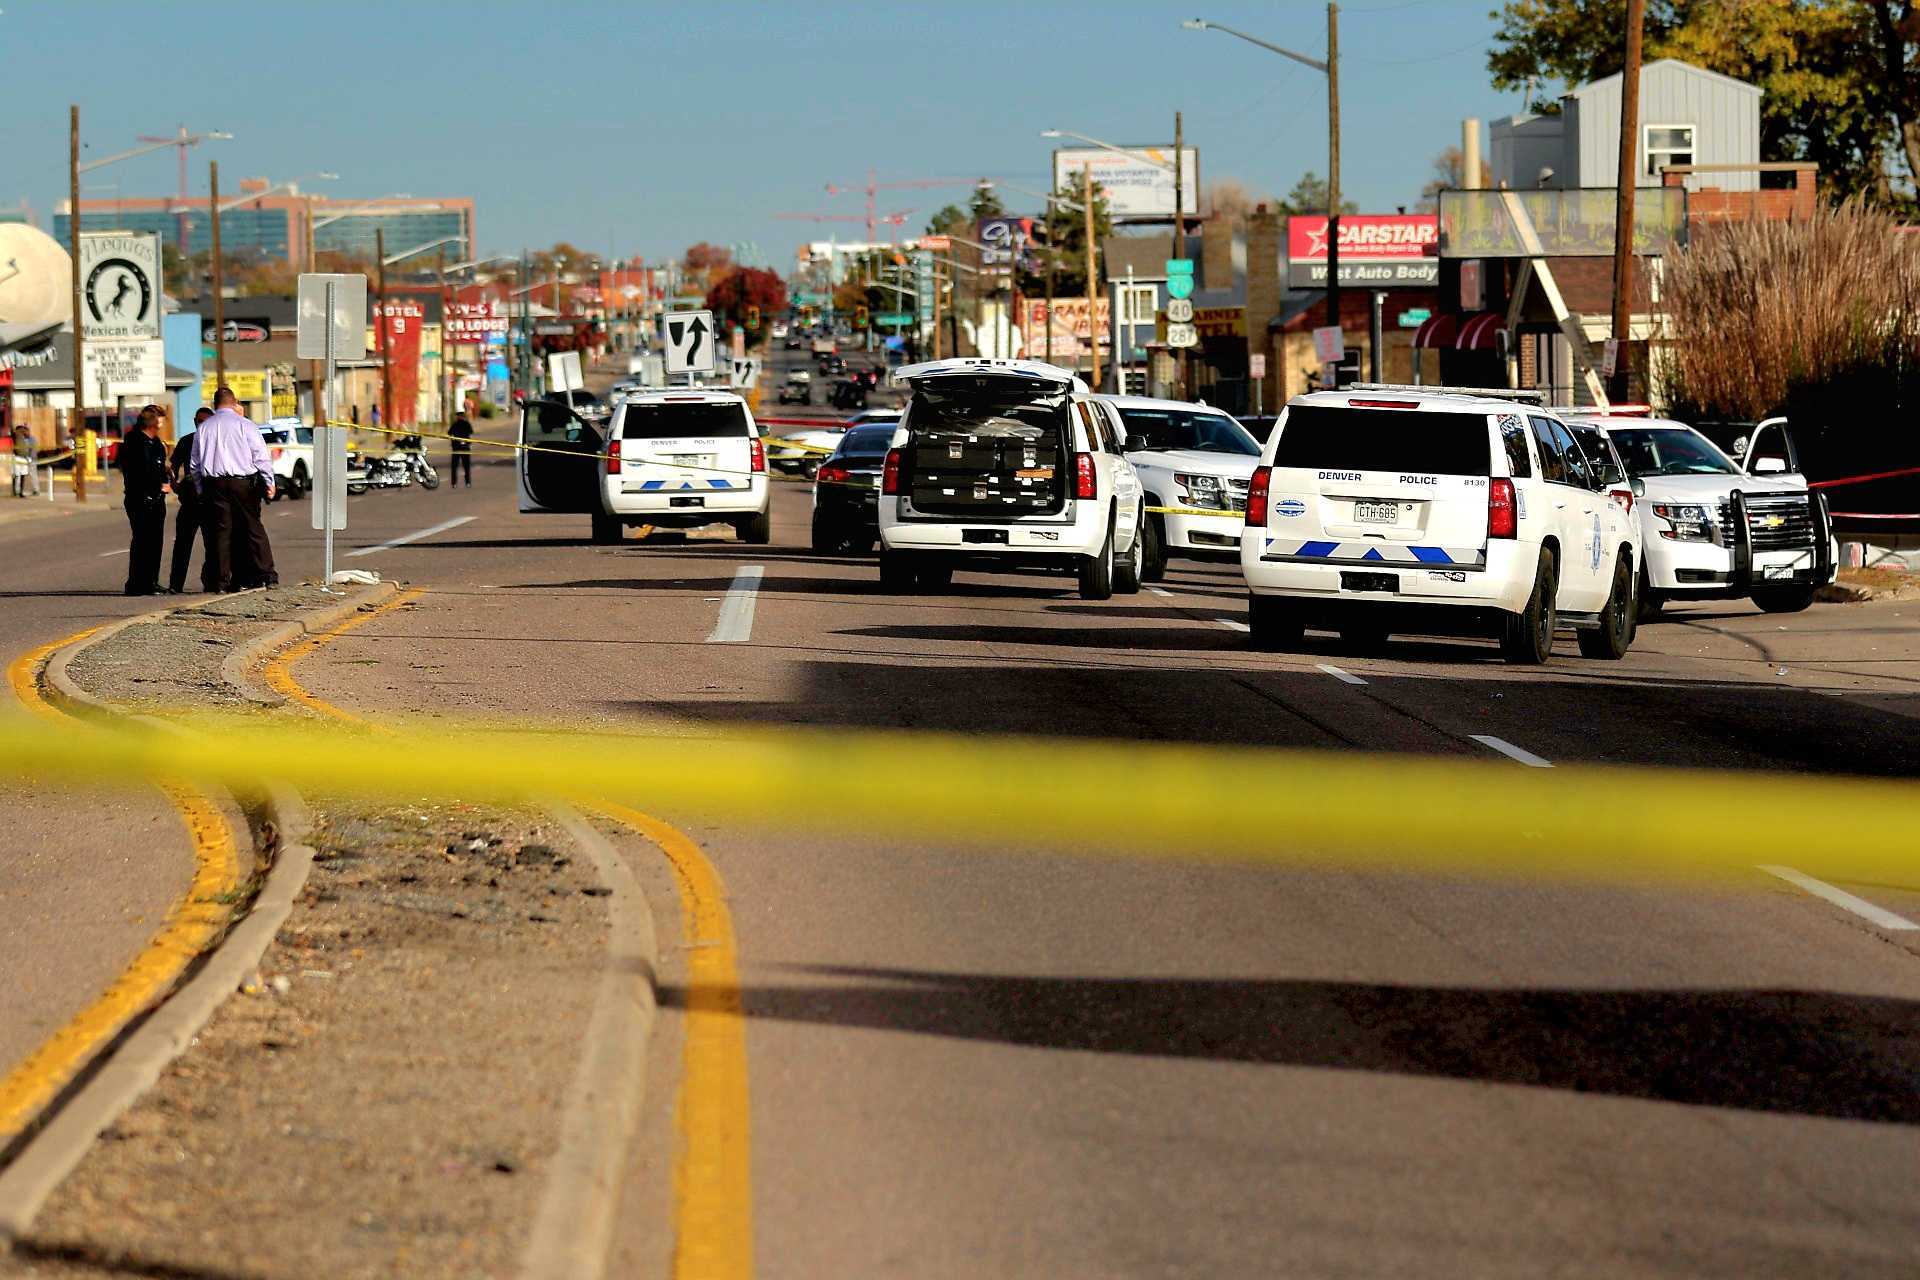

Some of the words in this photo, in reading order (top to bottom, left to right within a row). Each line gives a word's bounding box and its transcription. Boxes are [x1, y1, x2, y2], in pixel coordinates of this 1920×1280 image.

[1337, 224, 1434, 244] CARSTAR
[1311, 267, 1352, 280] Wst
[1355, 266, 1392, 280] Auto
[1396, 265, 1437, 282] Body
[1171, 304, 1190, 318] 40
[83, 326, 129, 337] Mexican
[394, 318, 406, 333] 9
[466, 320, 509, 332] LODGE
[1170, 329, 1194, 343] 287
[1318, 471, 1362, 481] DENVER
[1399, 475, 1438, 485] POLICE
[1463, 479, 1486, 487] 8130
